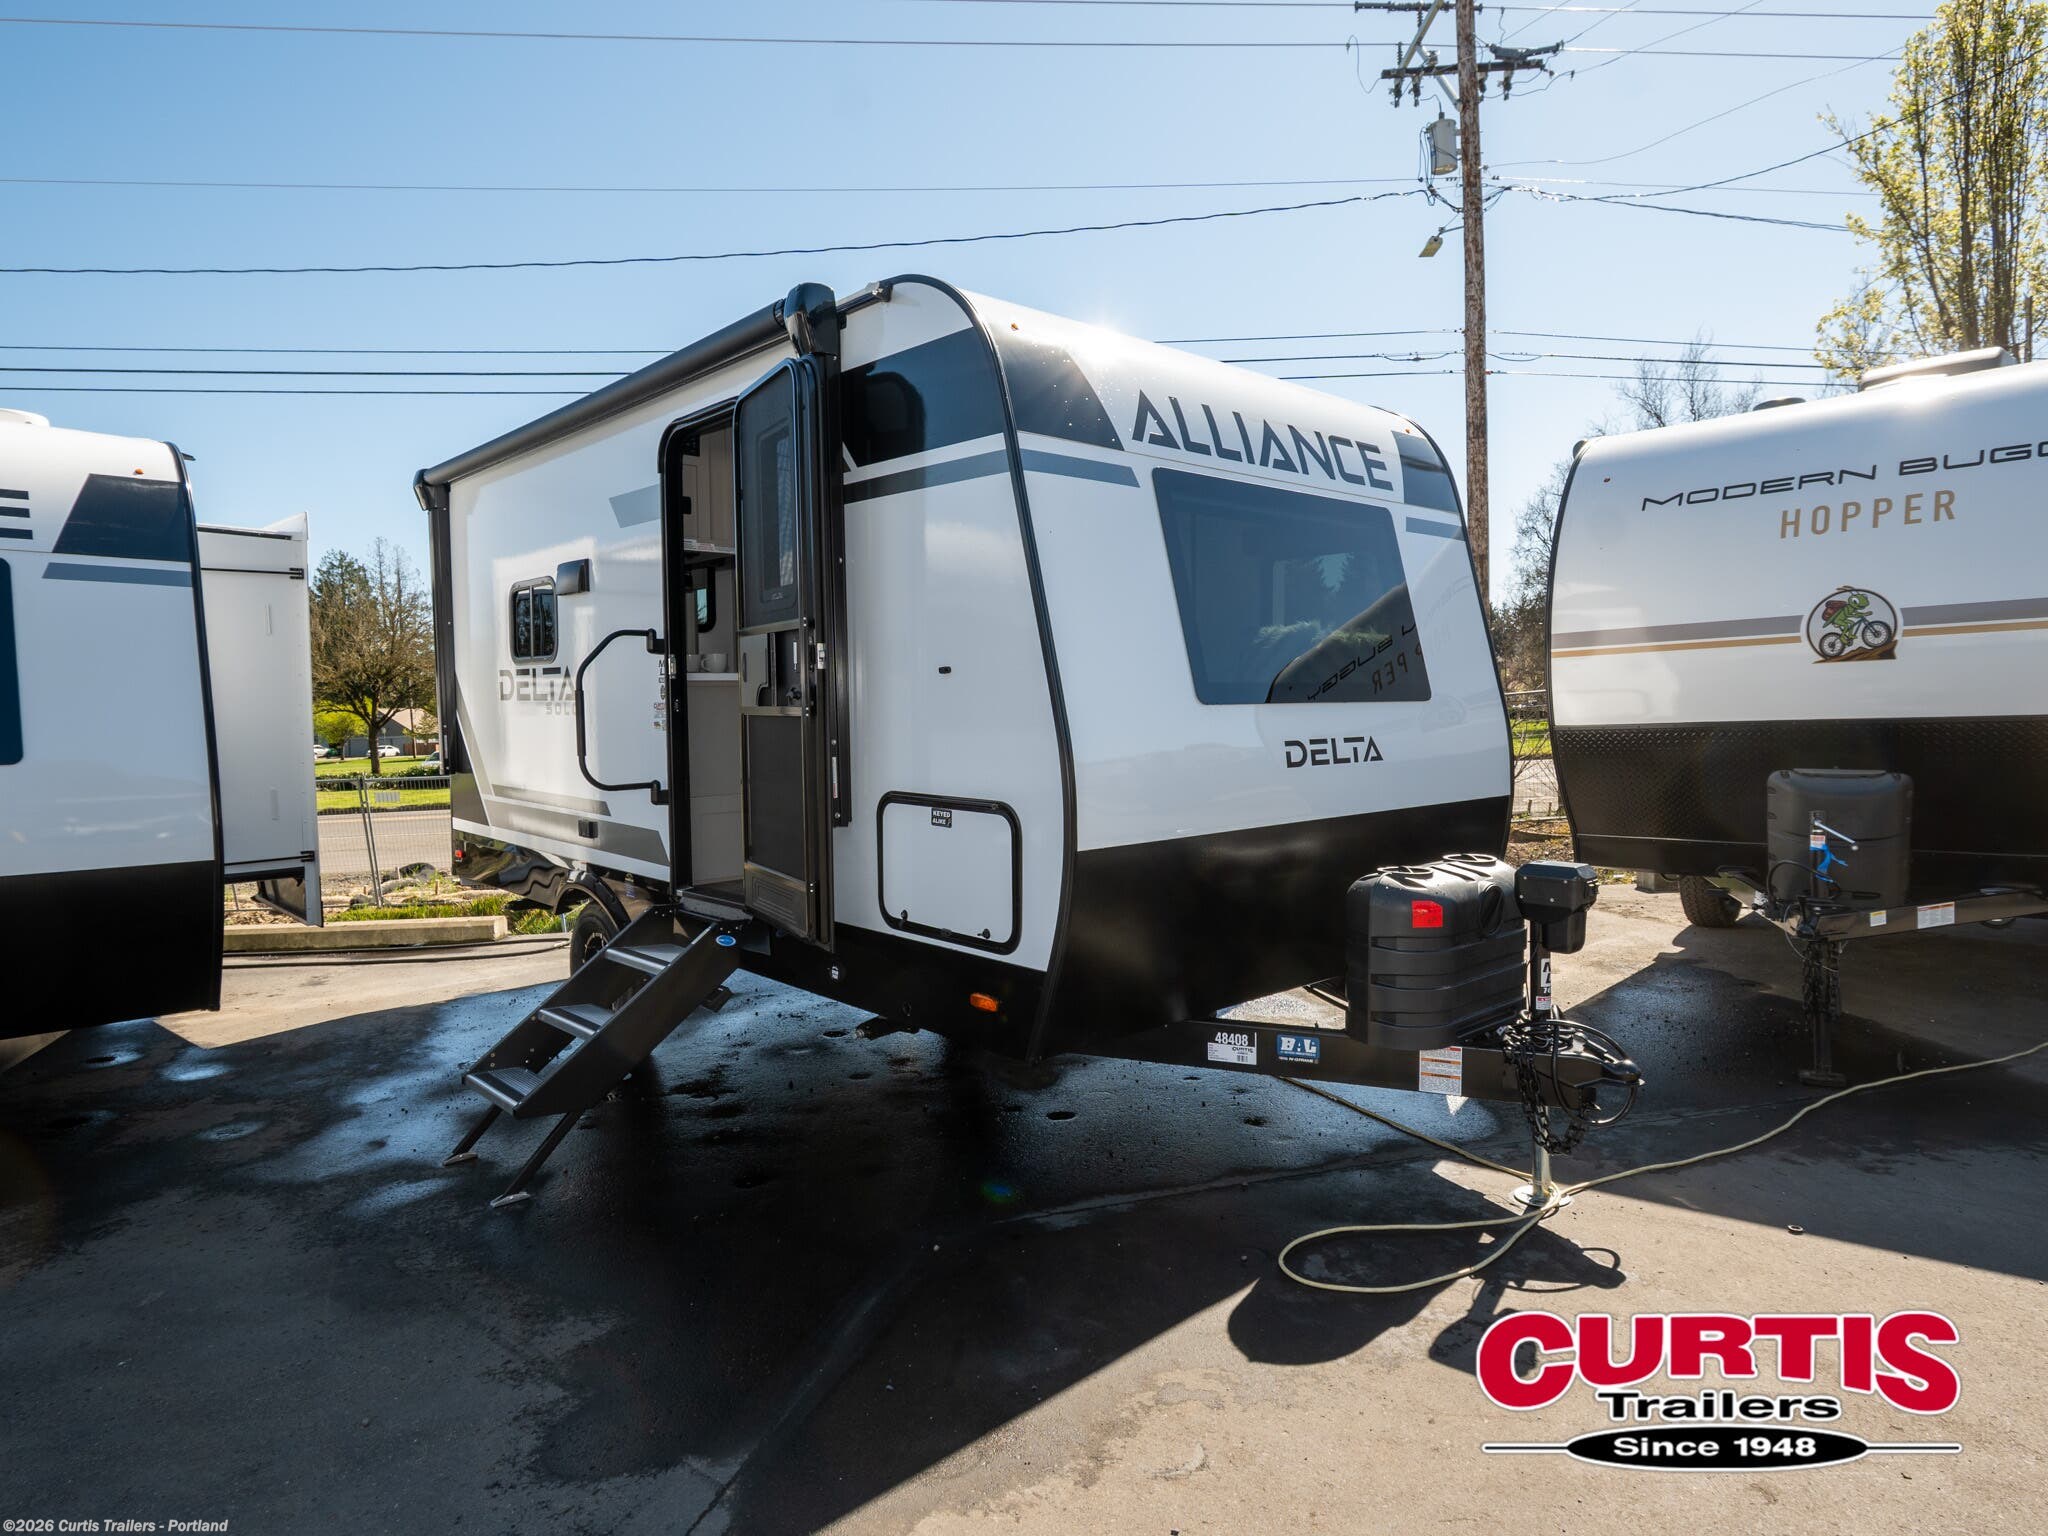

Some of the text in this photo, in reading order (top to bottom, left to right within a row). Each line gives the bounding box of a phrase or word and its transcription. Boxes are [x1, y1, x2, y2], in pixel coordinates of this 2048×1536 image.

[1132, 389, 1394, 491] ALLIANCE
[1641, 440, 2048, 511] MODERN BUG
[1779, 489, 1956, 539] HOPPER
[499, 665, 576, 701] DELTA
[1284, 735, 1384, 769] DELTA
[932, 810, 951, 818] KEYED
[1215, 1031, 1249, 1047] 48408
